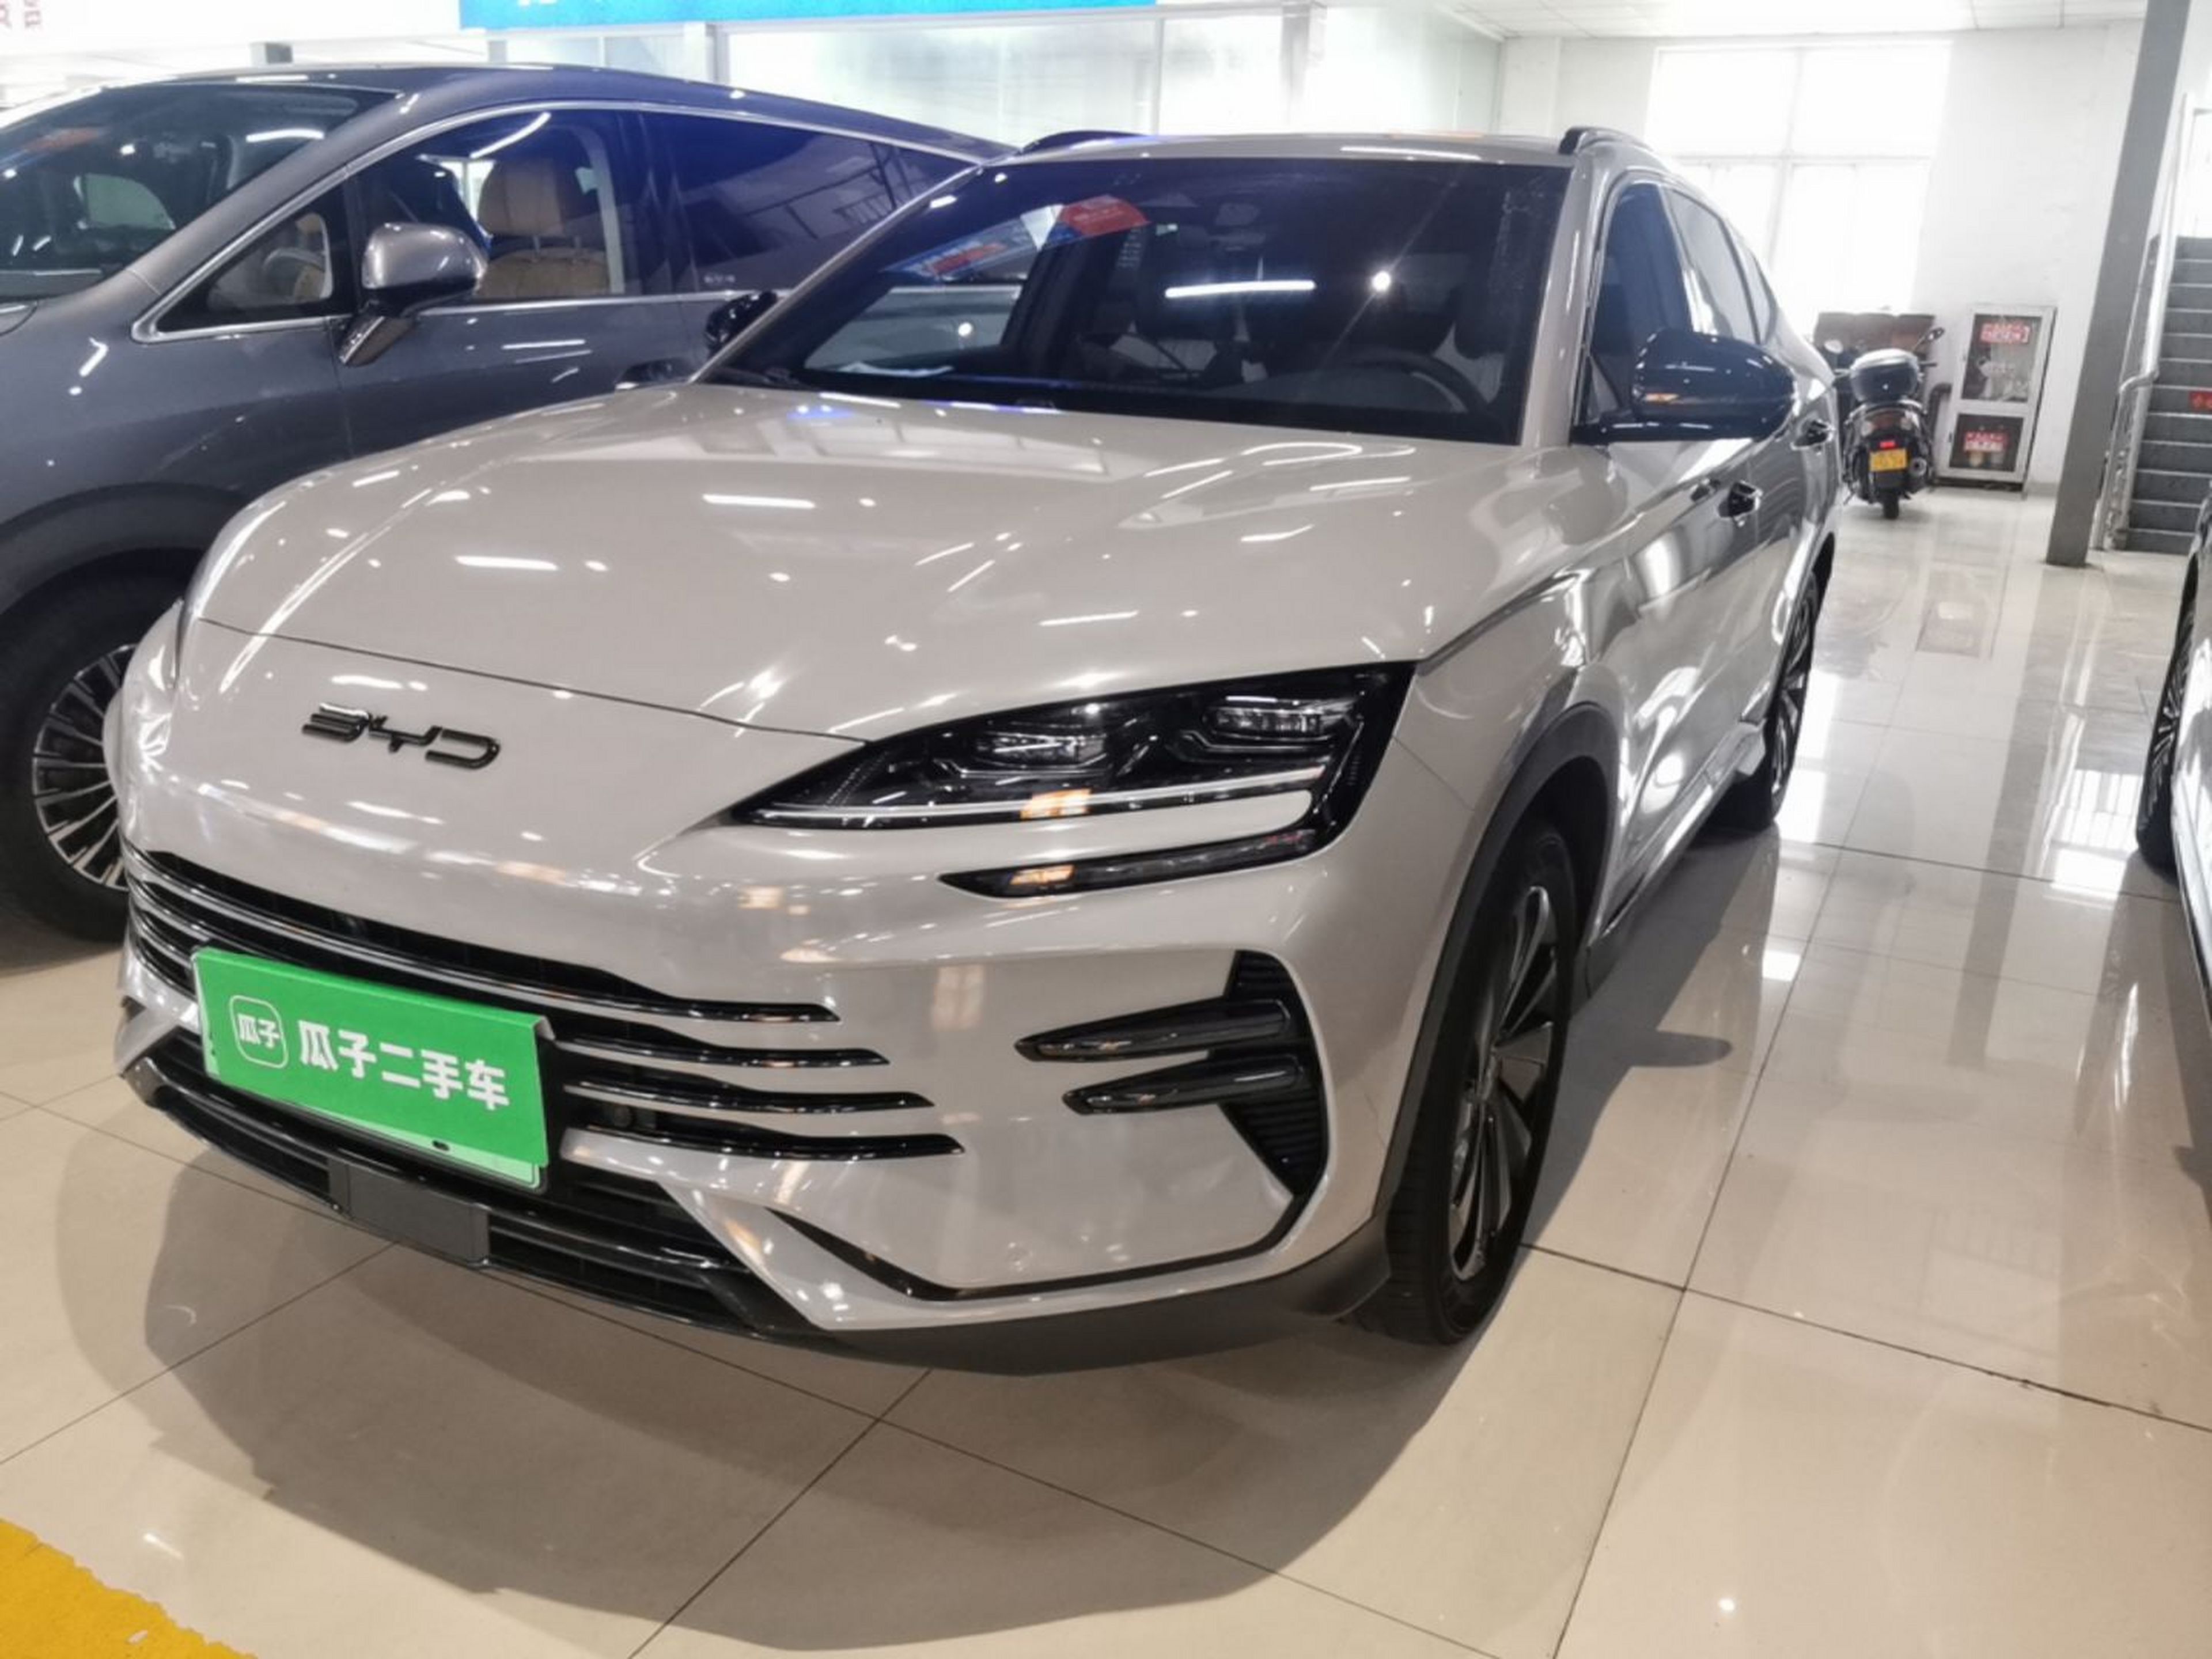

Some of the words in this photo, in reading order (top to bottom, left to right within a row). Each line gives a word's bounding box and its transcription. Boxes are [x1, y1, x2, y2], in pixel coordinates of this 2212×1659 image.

[302, 702, 501, 770] BYD
[237, 1013, 281, 1048] 瓜子
[298, 1019, 510, 1111] 瓜子二手车
